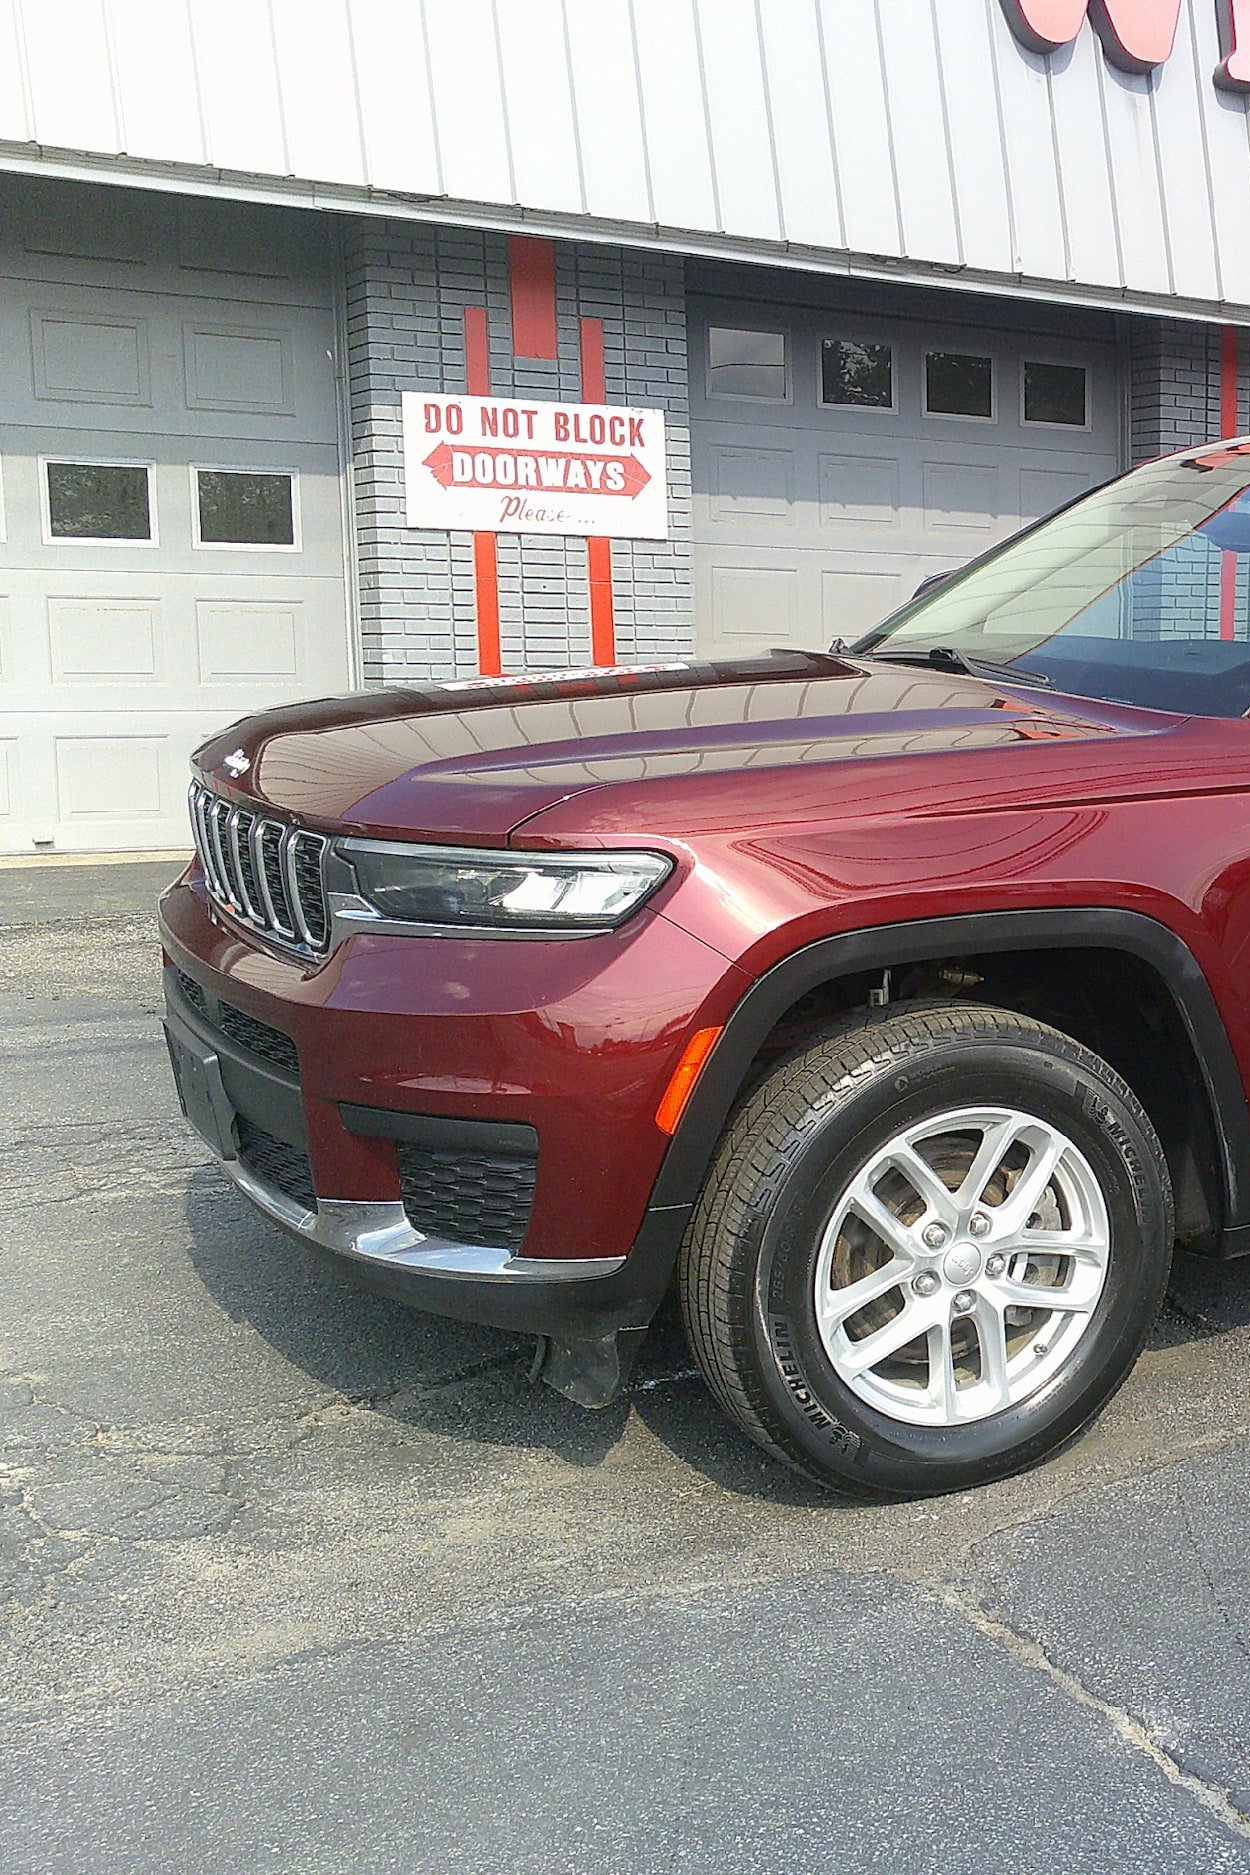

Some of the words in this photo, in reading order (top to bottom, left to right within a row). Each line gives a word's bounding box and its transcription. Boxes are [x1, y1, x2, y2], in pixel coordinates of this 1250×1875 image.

[424, 403, 463, 435] DO
[480, 406, 538, 440] NOT
[554, 411, 645, 447] BLOCK
[451, 451, 626, 492] DOORWAYS
[1107, 1121, 1151, 1224] MICHELIN
[773, 1321, 832, 1431] MICHELIN
